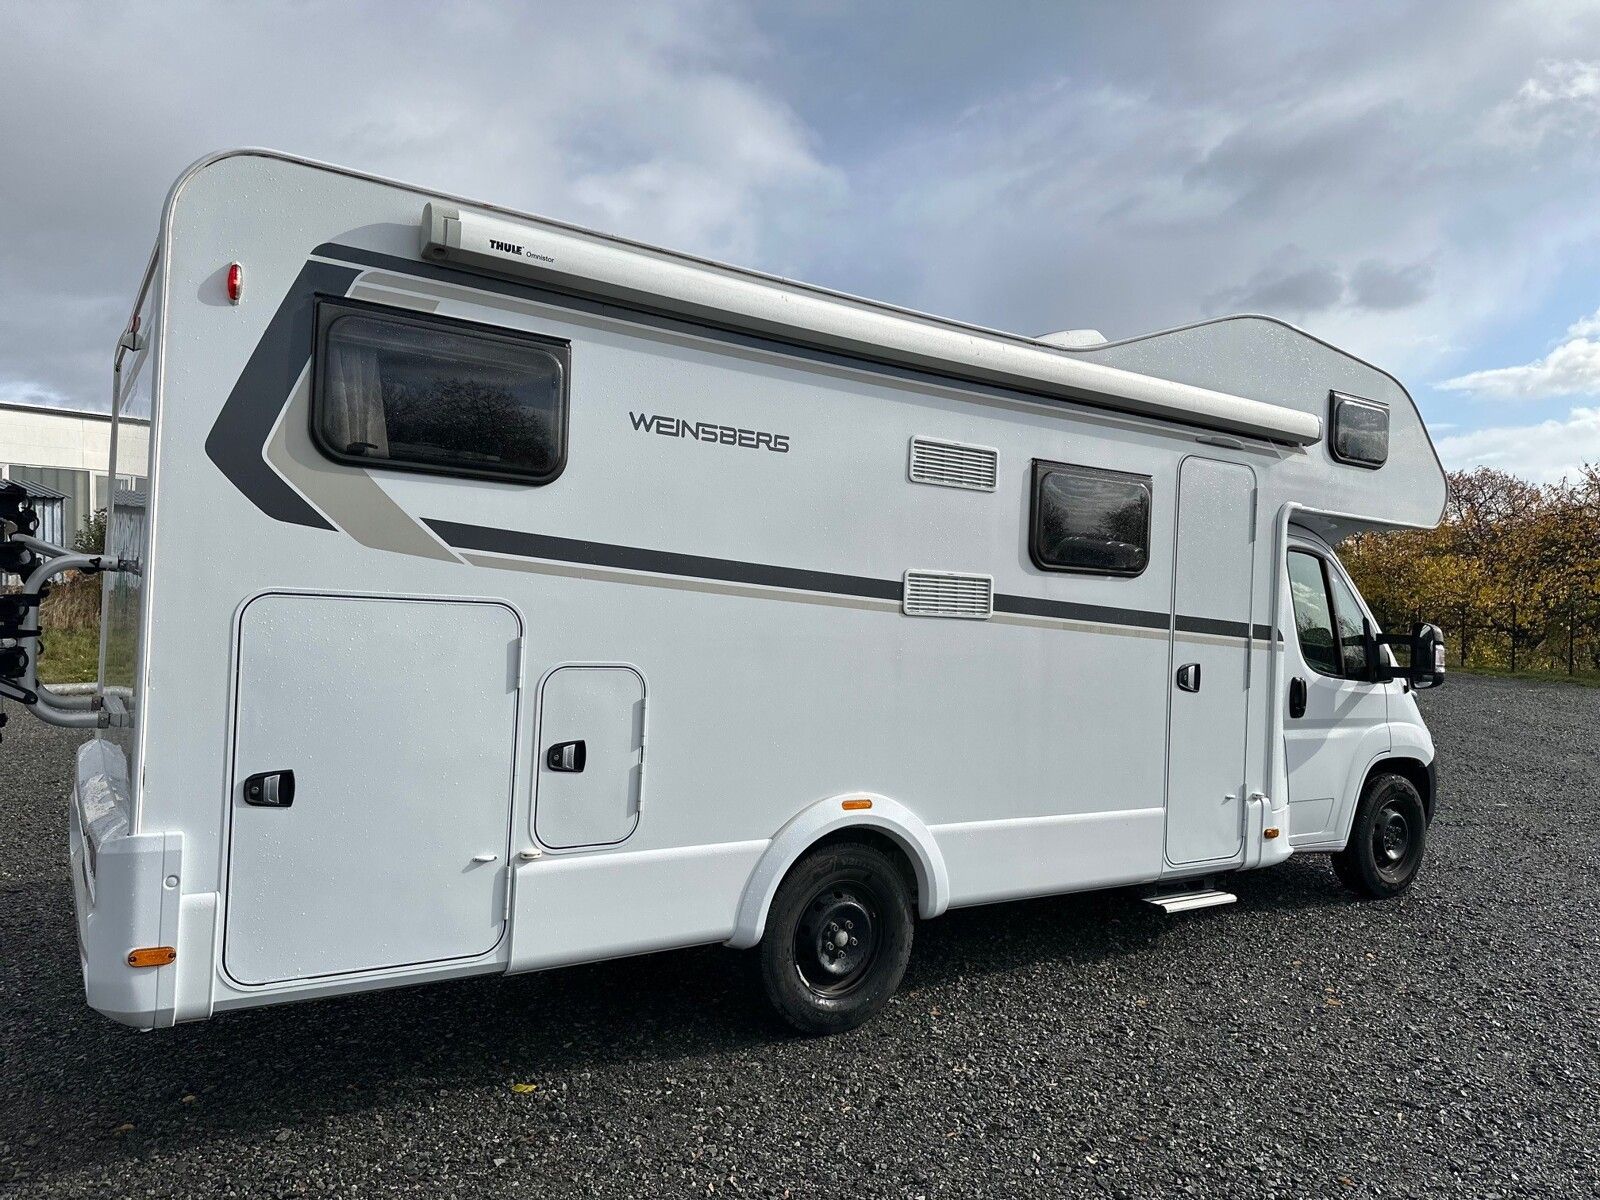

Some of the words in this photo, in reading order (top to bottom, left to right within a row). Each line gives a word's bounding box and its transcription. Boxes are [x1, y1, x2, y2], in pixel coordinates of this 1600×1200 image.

[489, 239, 523, 256] THULE
[526, 251, 555, 263] Omnistor
[629, 411, 790, 453] WEINSBERG
